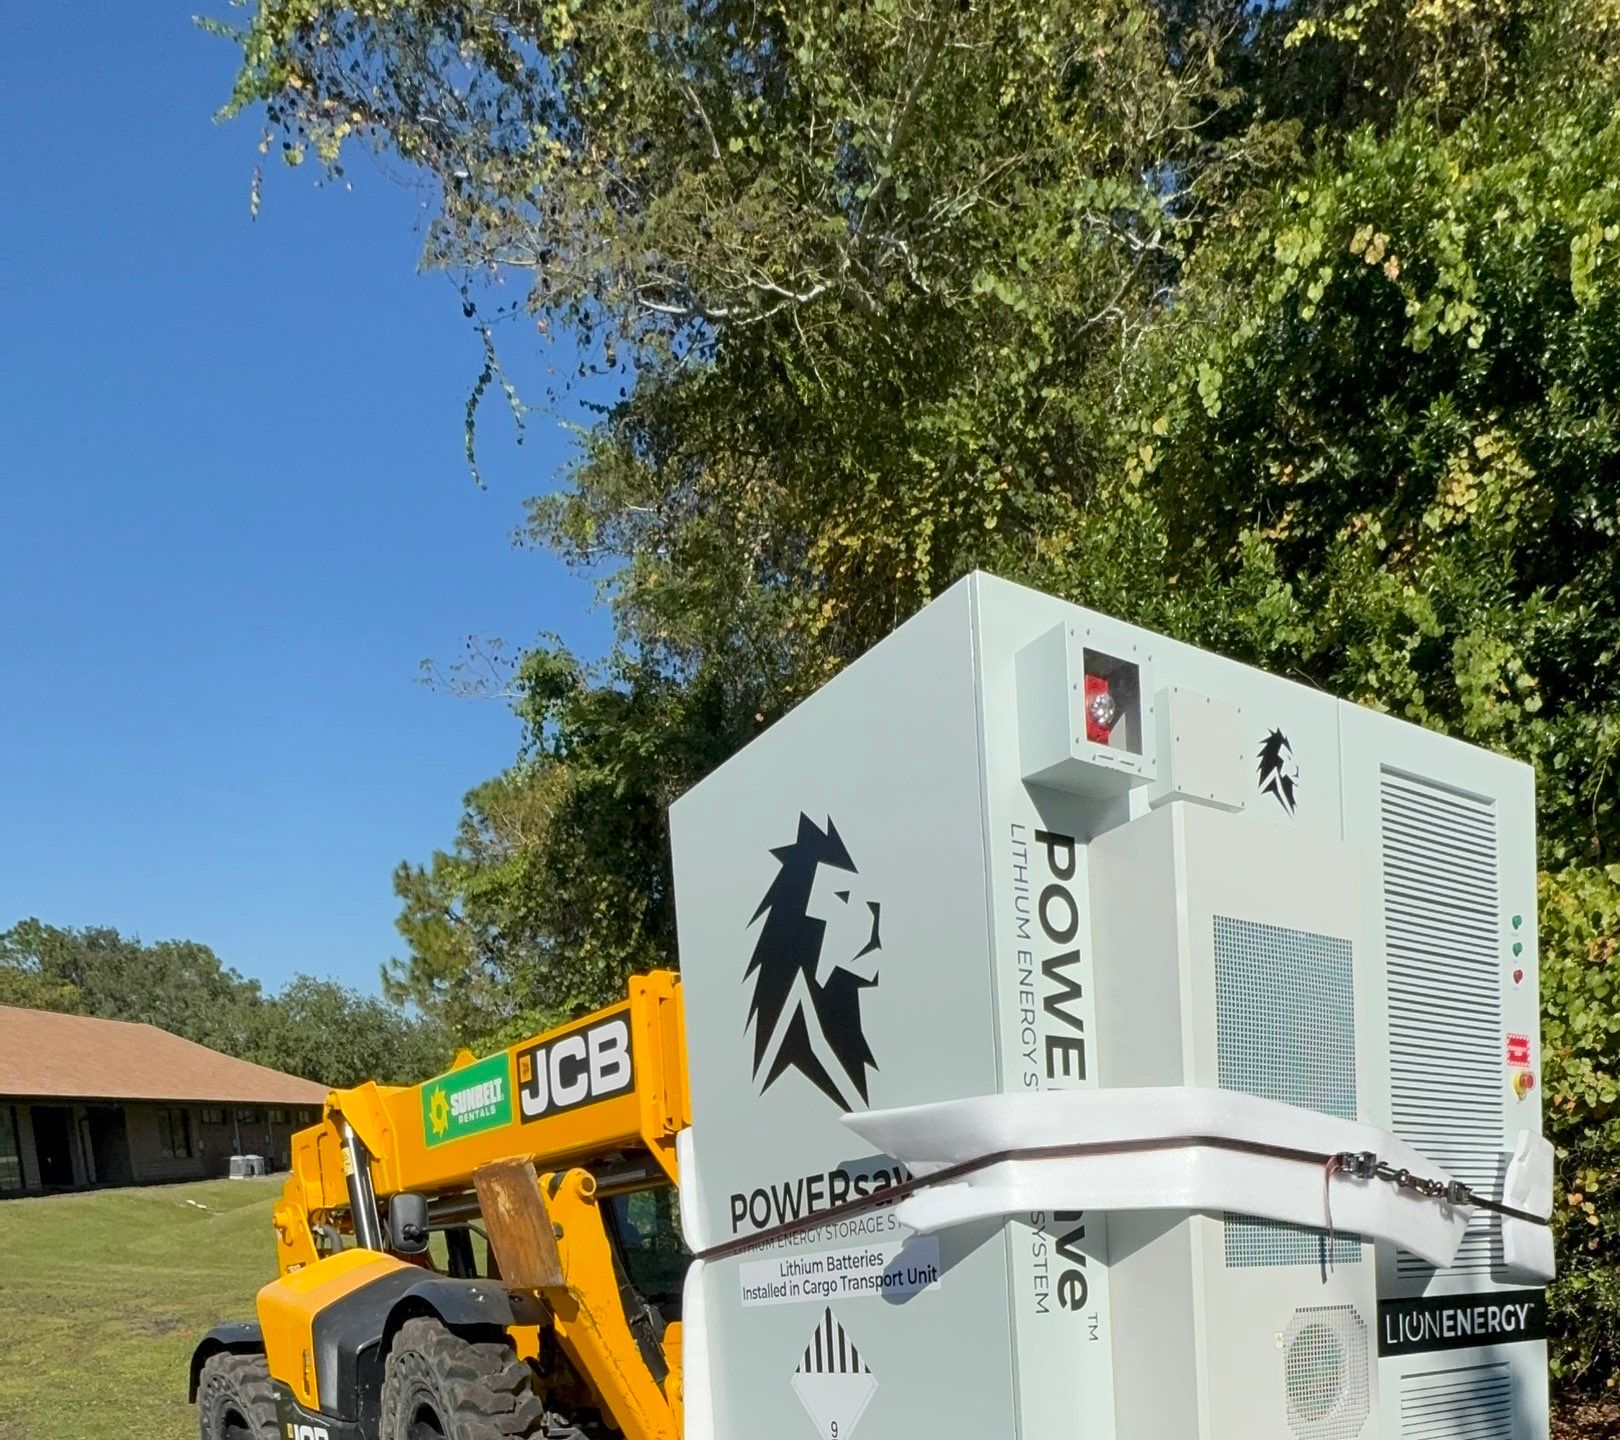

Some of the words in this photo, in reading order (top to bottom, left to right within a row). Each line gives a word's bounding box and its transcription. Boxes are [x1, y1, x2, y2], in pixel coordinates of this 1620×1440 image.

[1010, 823, 1031, 940] LITHIUM
[1017, 950, 1038, 1065] ENERGY
[521, 1020, 631, 1116] JCB
[450, 1077, 502, 1116] SUNBELT
[458, 1104, 496, 1124] RENTALS
[730, 1166, 914, 1234] POWERsav
[778, 1227, 823, 1249] ENERGY
[825, 1215, 884, 1241] STORAGE
[743, 1280, 787, 1300] Installed
[789, 1279, 800, 1296] in
[802, 1276, 838, 1297] Cargo
[840, 1269, 904, 1291] Transport
[907, 1264, 938, 1285] Unit
[780, 1259, 823, 1277] Lithium
[827, 1252, 884, 1271] Batteries
[1030, 1211, 1050, 1314] SYSTEM
[830, 1421, 839, 1438] 9
